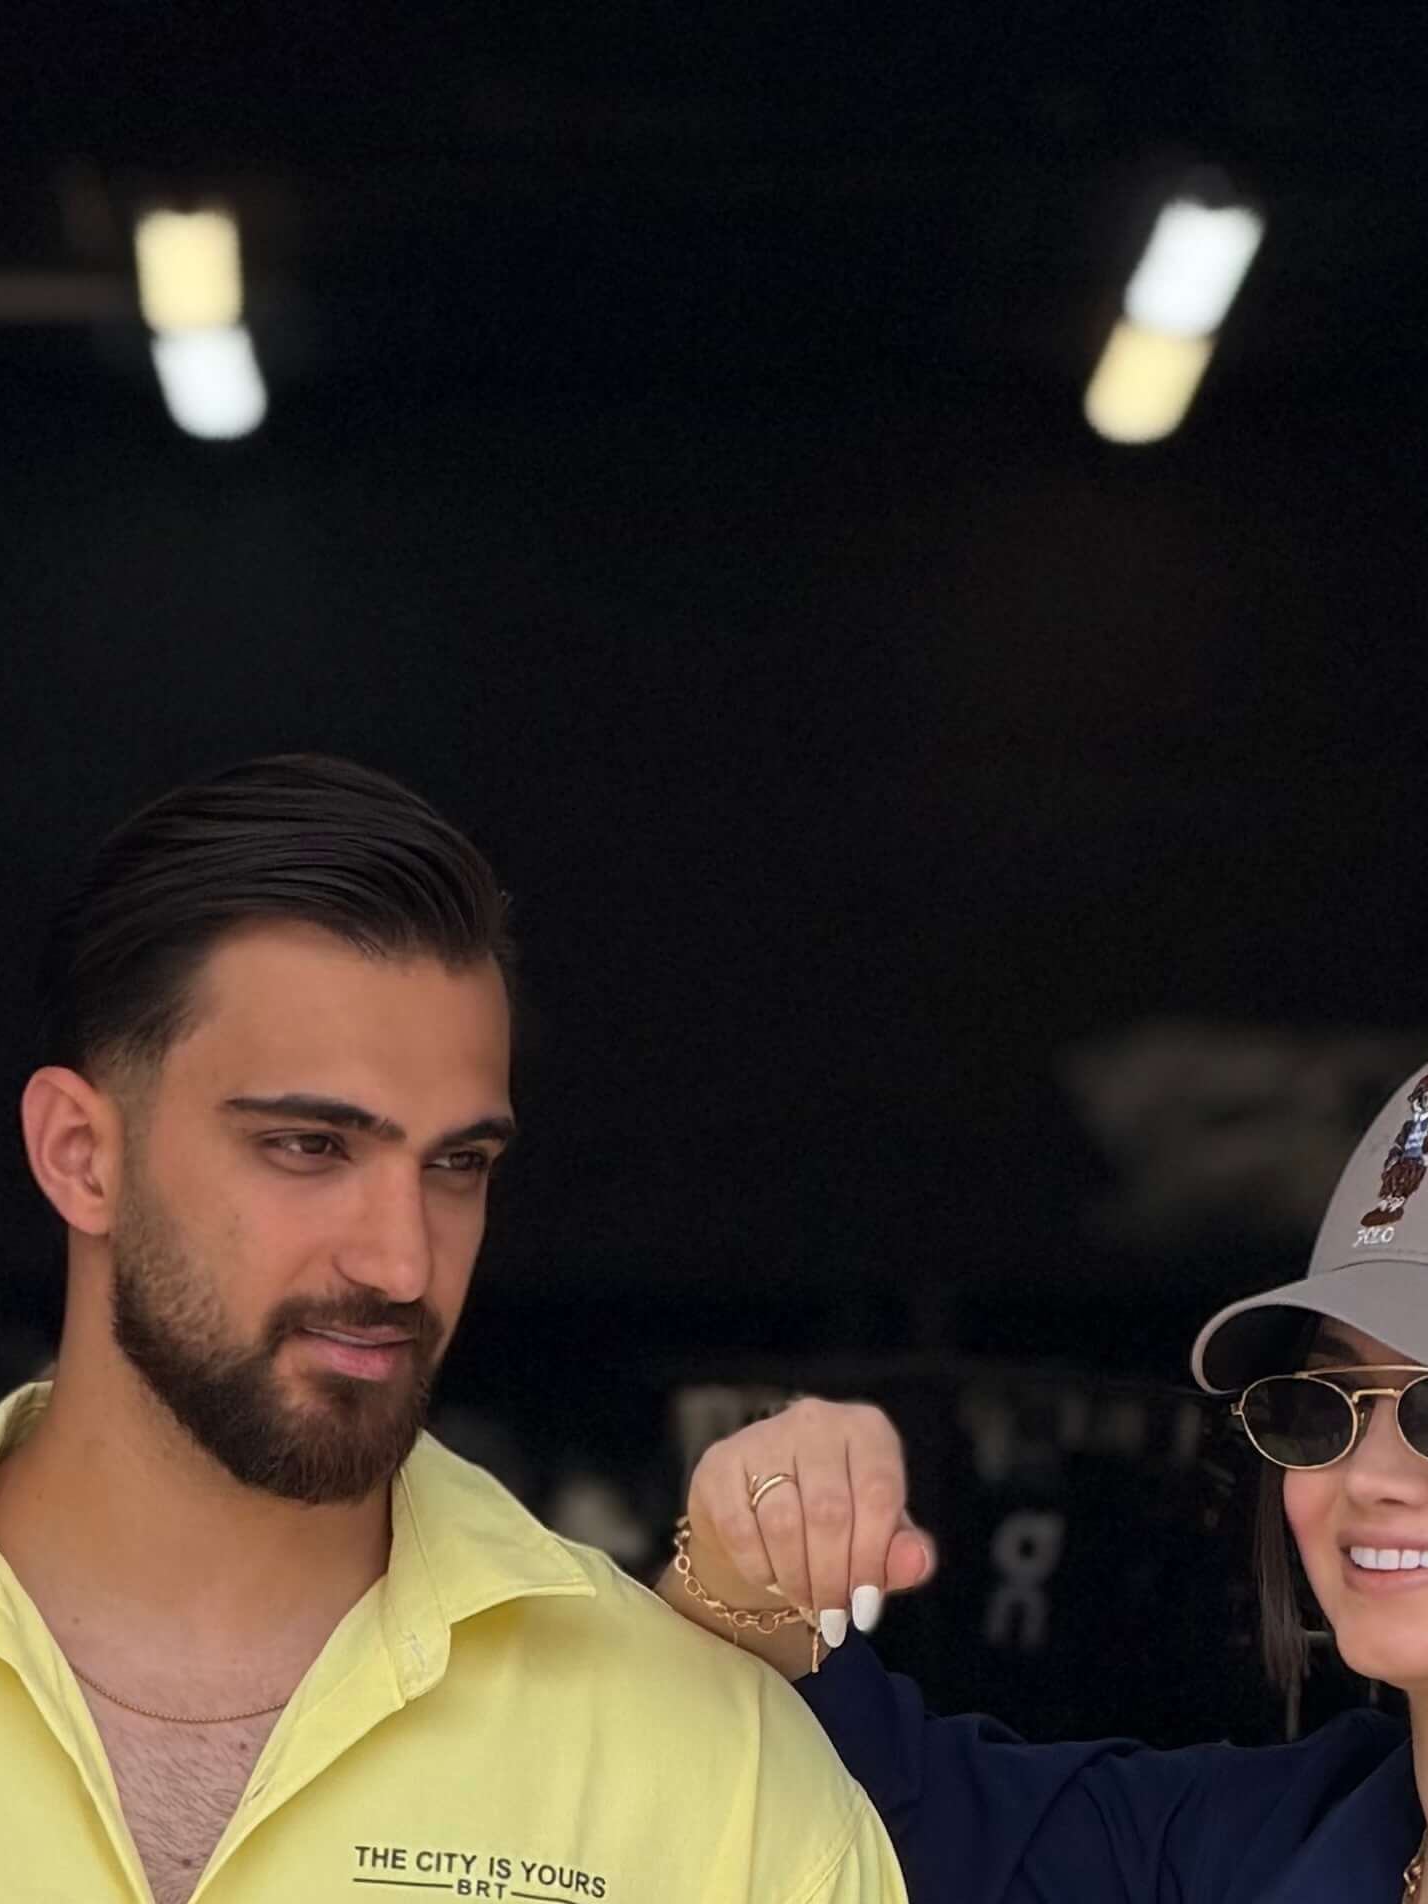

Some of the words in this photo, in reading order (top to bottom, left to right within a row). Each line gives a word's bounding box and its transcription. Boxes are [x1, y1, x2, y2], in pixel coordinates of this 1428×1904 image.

[355, 1846, 407, 1869] THE
[416, 1851, 477, 1875] CITY
[489, 1857, 512, 1879] IS
[521, 1861, 607, 1899] YOURS
[457, 1879, 509, 1900] BRT
